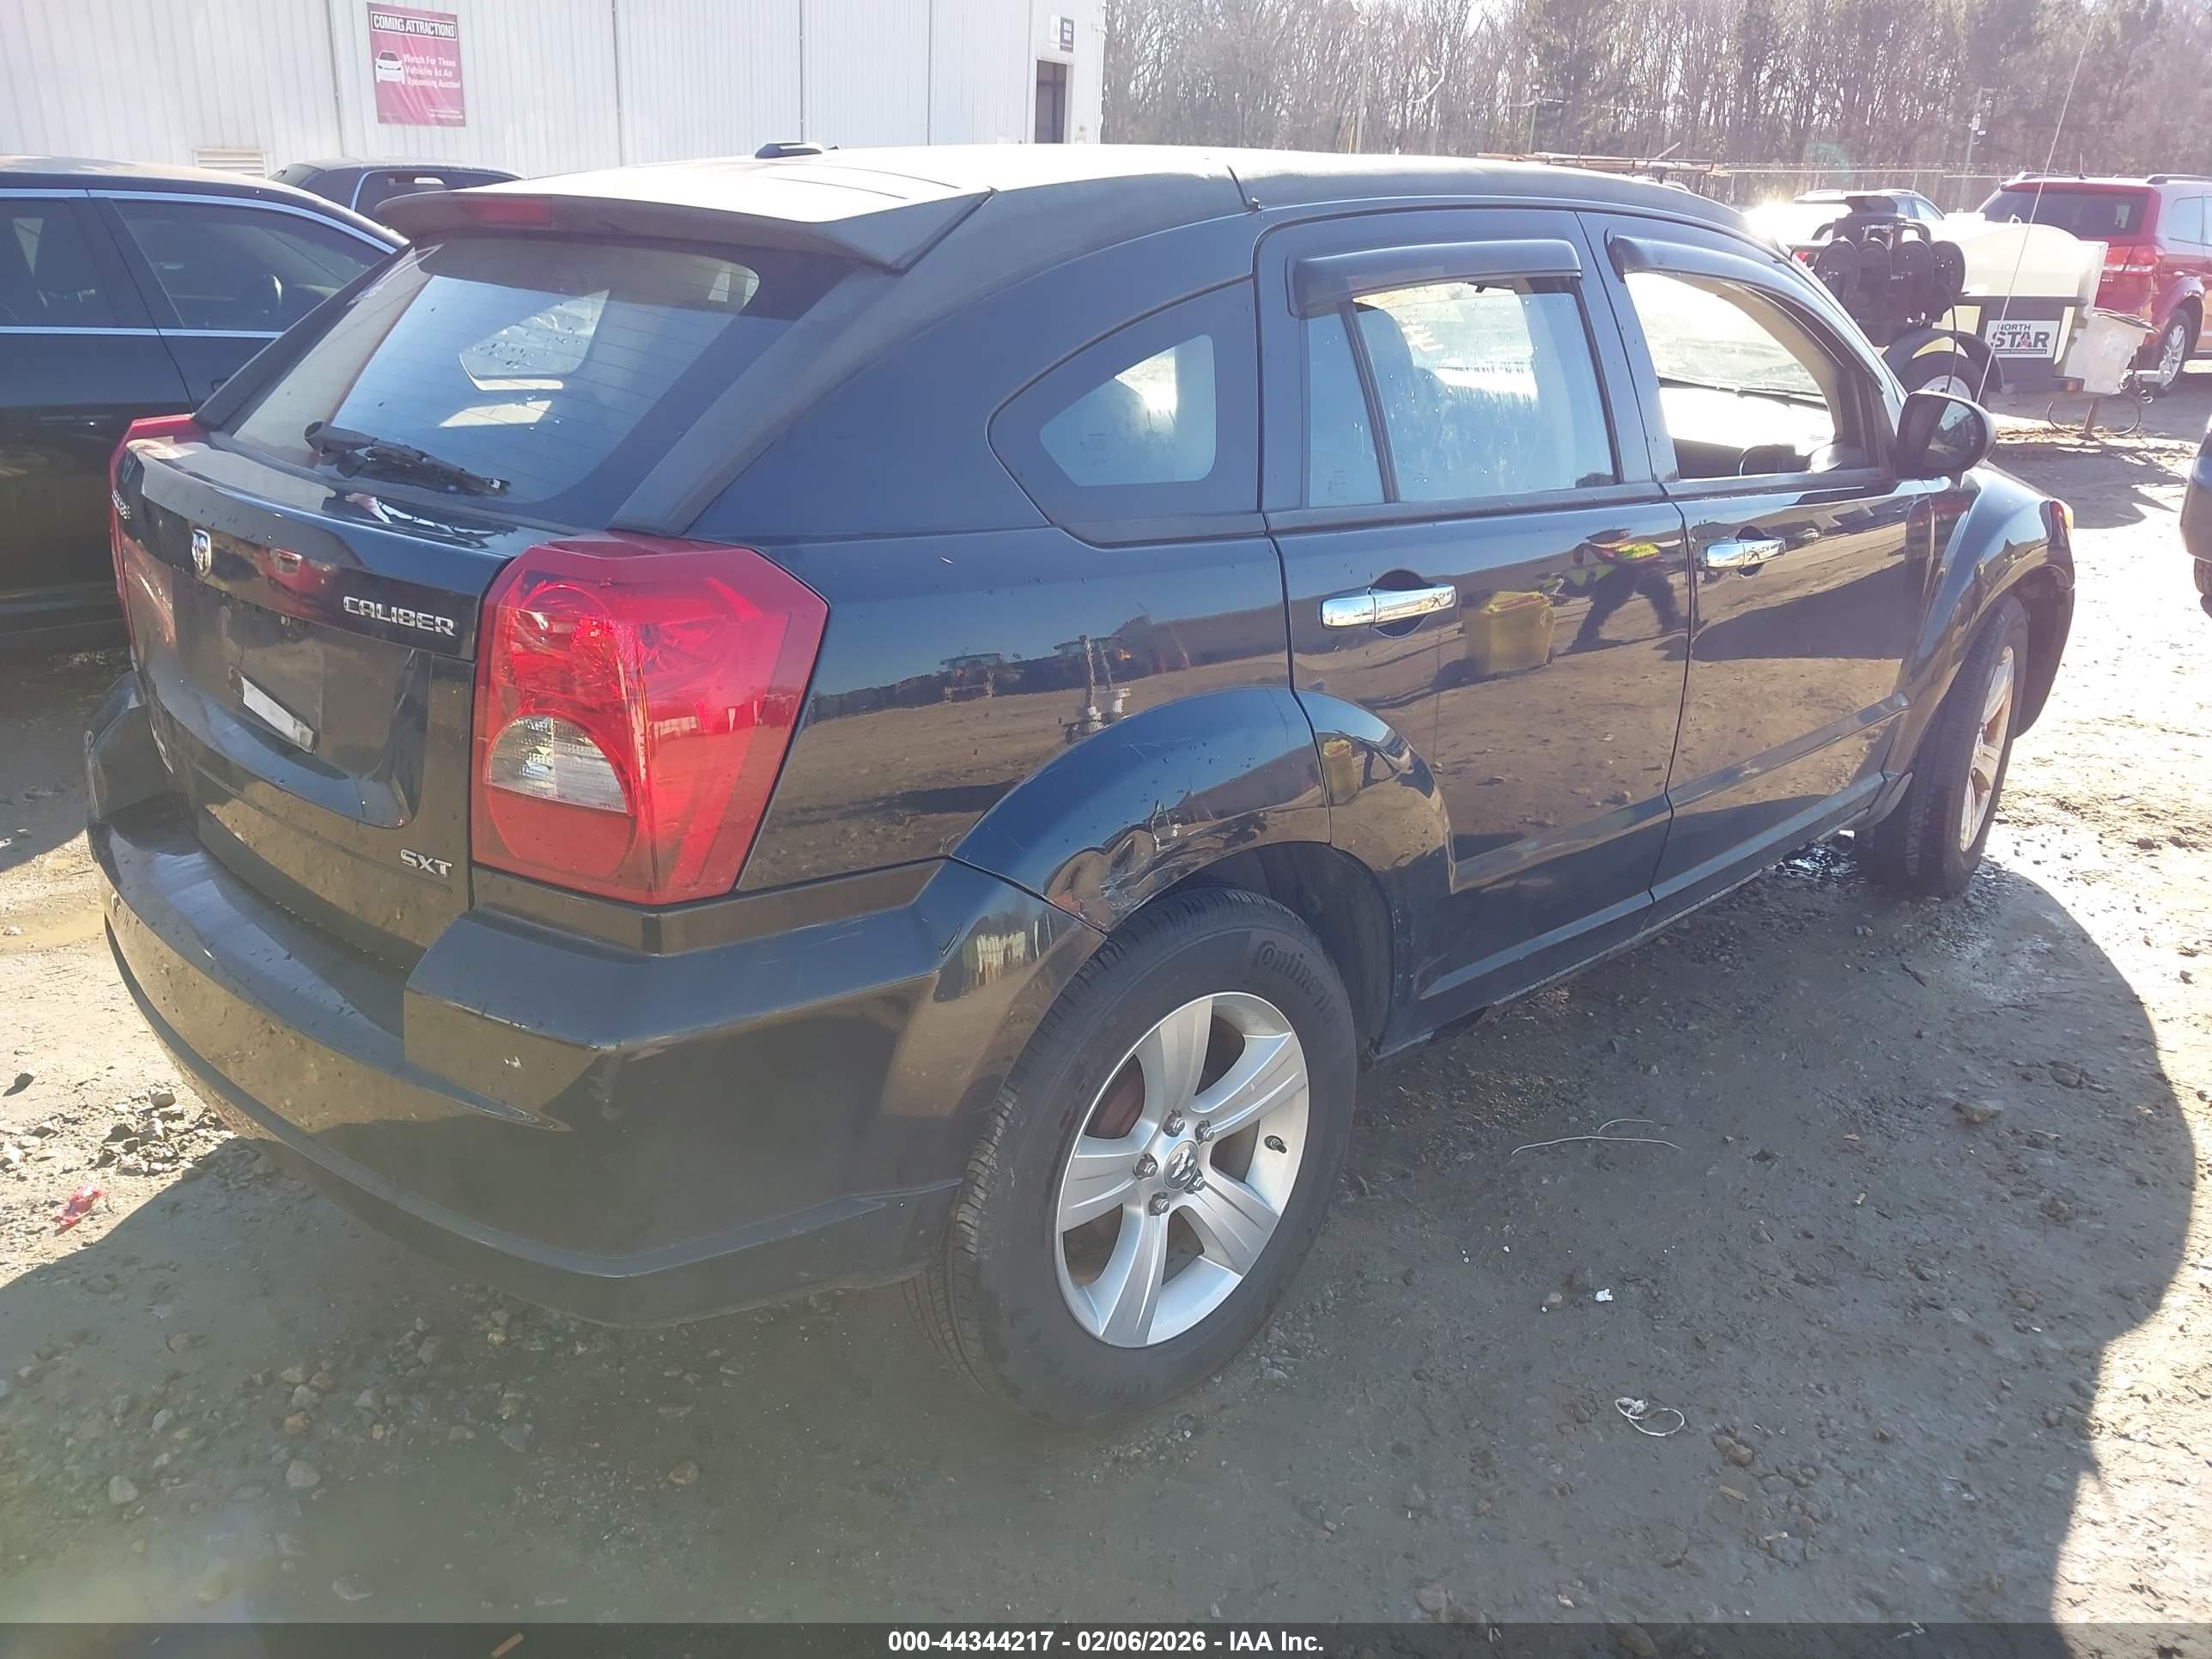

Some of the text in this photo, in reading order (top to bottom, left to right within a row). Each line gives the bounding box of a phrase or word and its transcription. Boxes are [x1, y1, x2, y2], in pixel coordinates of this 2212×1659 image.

[374, 15, 455, 38] COMING ATTRACTIONS
[1990, 331, 2051, 349] STAR
[343, 596, 456, 636] CALIBER
[400, 848, 453, 876] SXT
